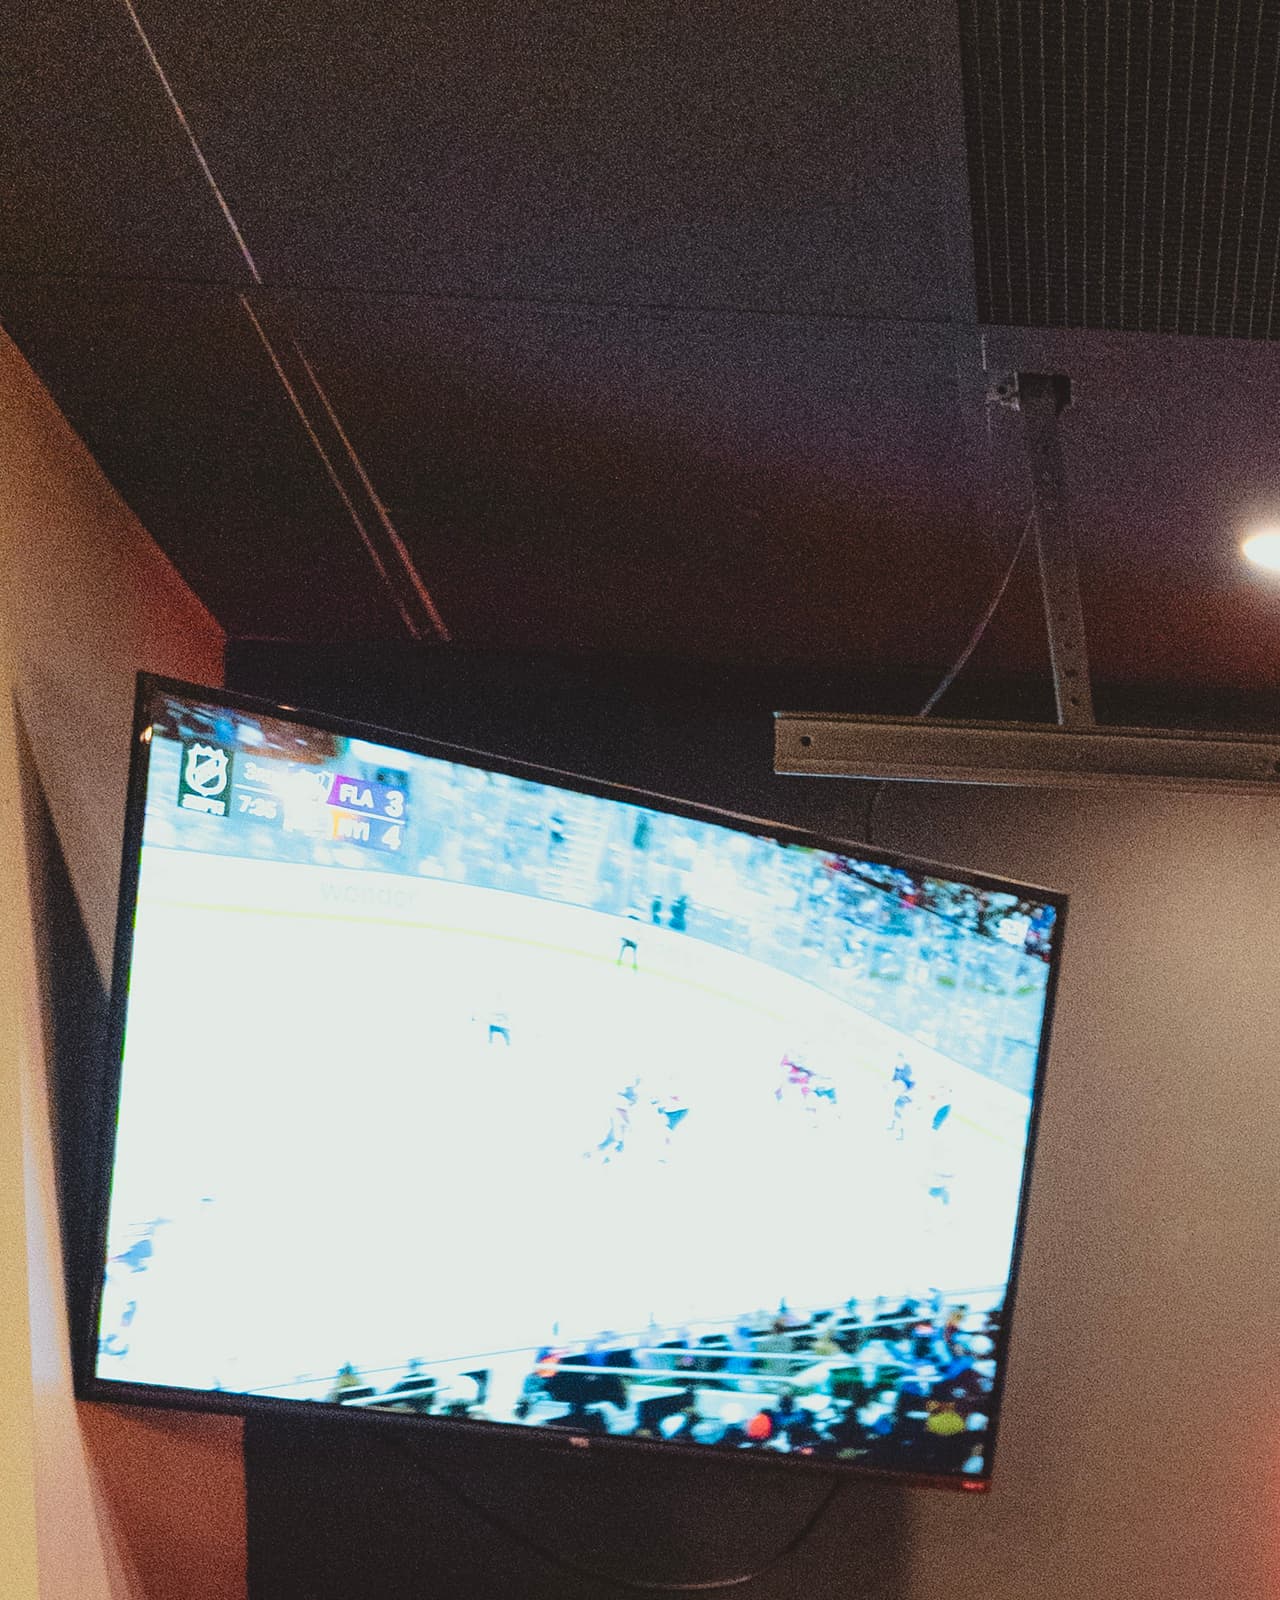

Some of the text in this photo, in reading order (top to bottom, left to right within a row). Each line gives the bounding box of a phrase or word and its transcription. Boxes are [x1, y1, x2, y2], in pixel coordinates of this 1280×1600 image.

[340, 783, 404, 817] FLA 3
[382, 825, 401, 850] 4
